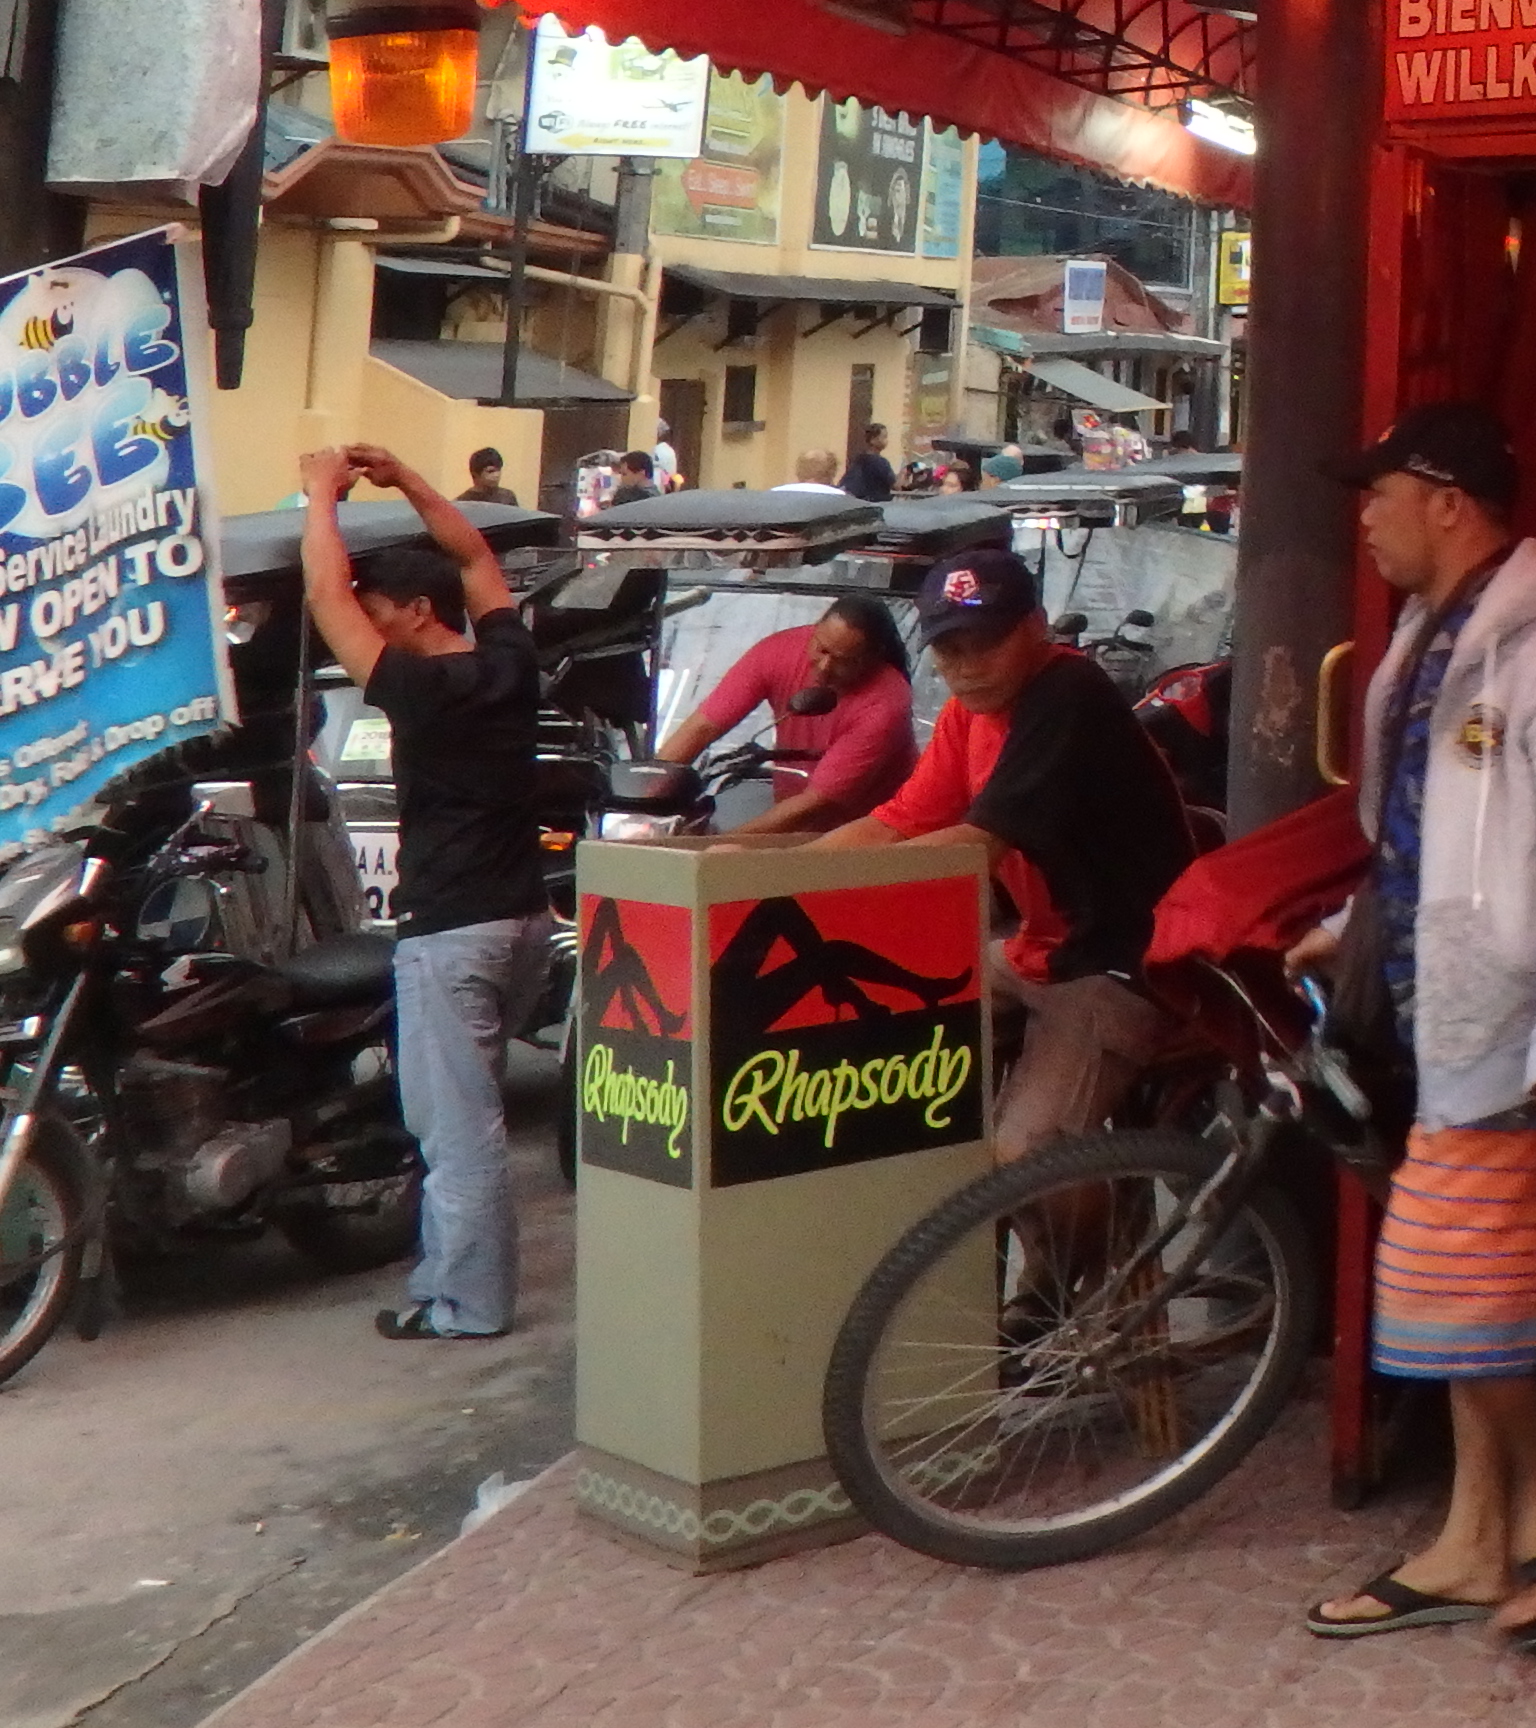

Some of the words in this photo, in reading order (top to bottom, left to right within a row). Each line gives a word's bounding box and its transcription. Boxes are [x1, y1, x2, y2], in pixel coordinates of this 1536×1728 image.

[613, 119, 648, 130] FREE
[88, 485, 196, 554] Laundry
[30, 554, 119, 638] OPEN
[125, 534, 204, 587] TO
[89, 601, 165, 668] YOU
[104, 714, 165, 751] Drop
[169, 695, 217, 725] off
[583, 1043, 688, 1159] Rhapsody
[722, 1024, 973, 1148] Rhapsody
